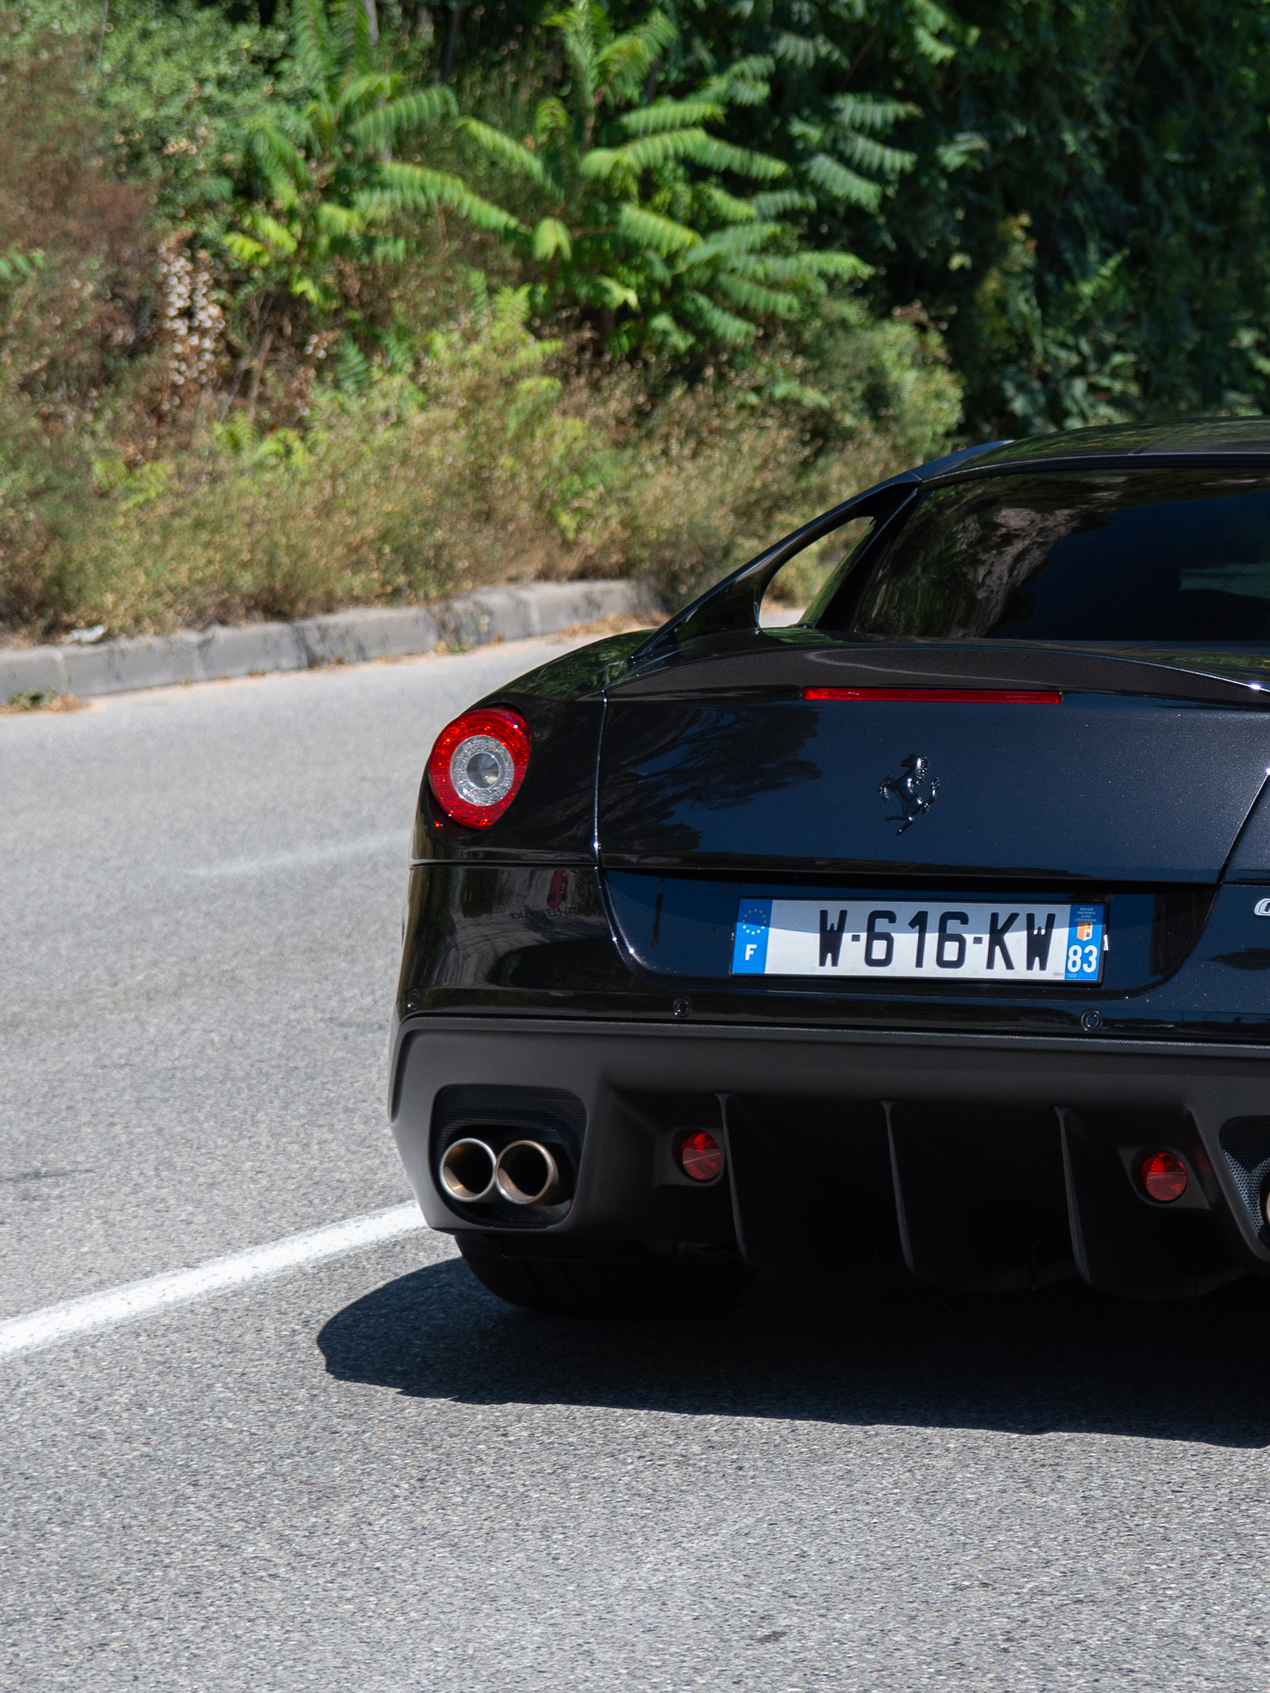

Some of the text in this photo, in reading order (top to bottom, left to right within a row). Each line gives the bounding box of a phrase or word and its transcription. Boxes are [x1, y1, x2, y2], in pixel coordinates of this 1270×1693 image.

[744, 943, 757, 961] F
[819, 910, 1056, 972] W-616-KW
[1066, 945, 1099, 973] 83
